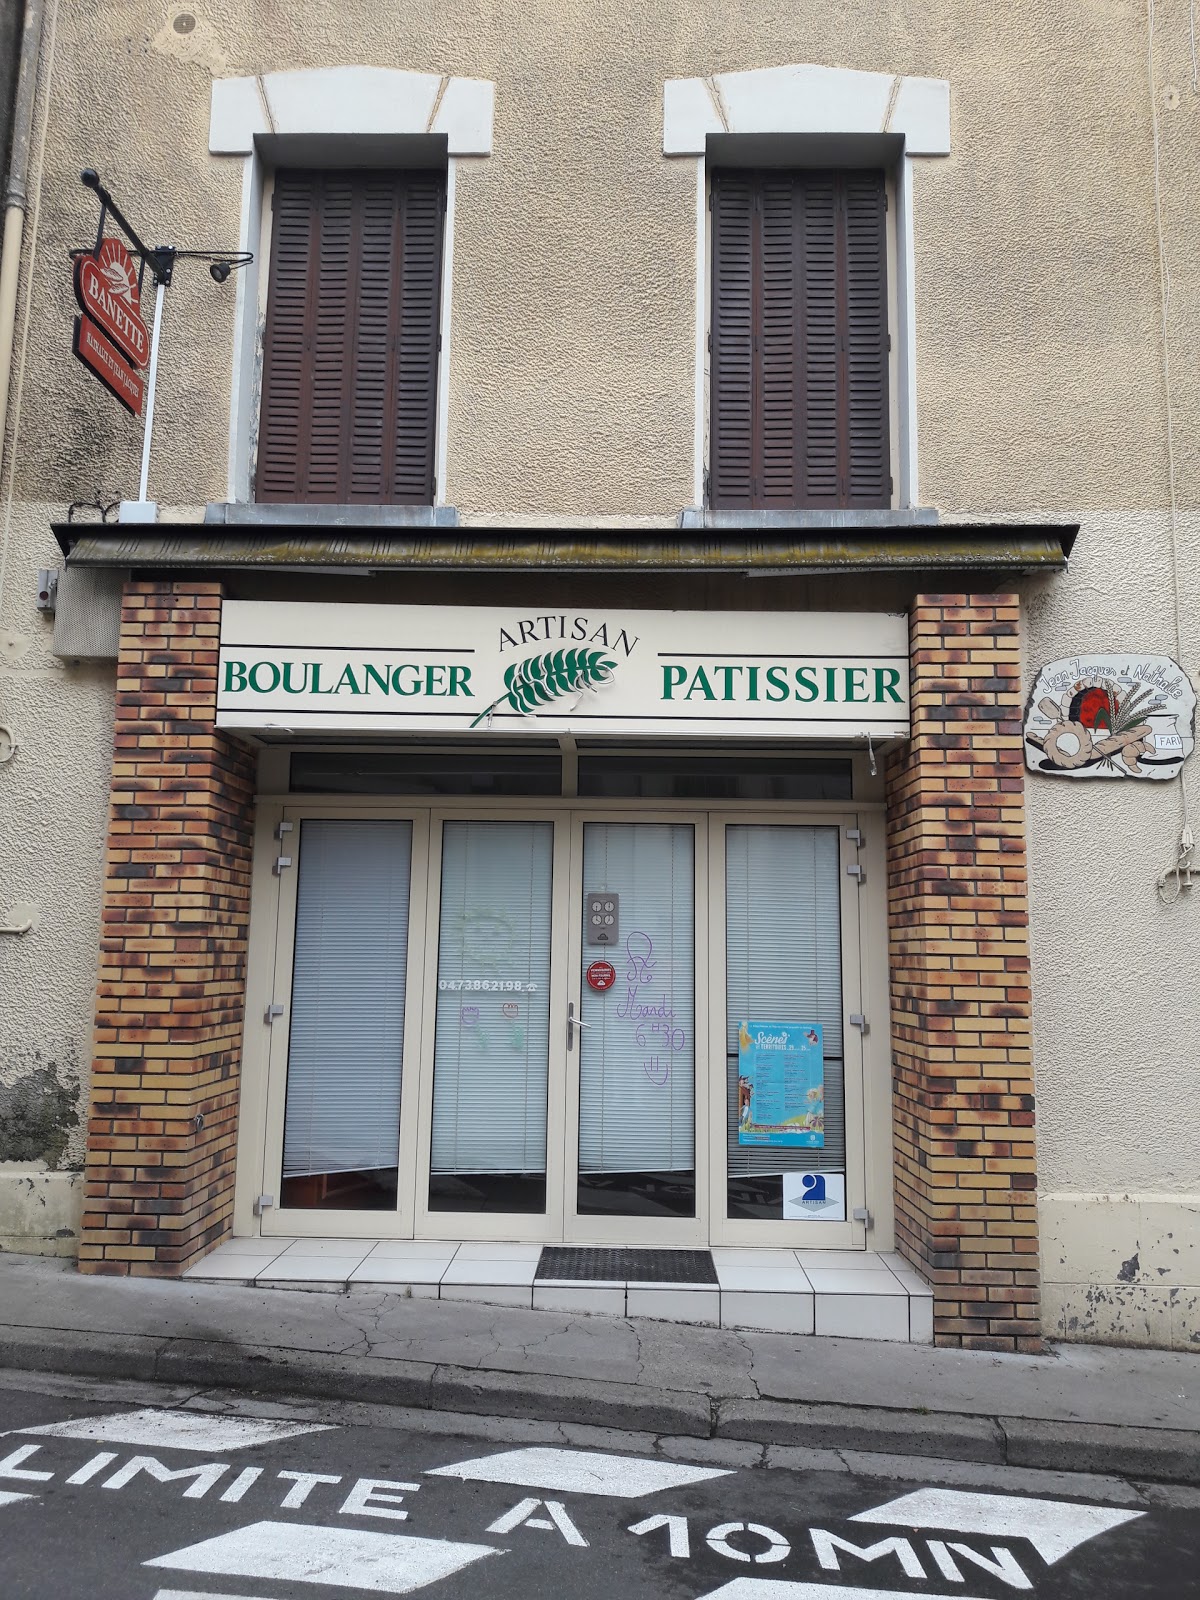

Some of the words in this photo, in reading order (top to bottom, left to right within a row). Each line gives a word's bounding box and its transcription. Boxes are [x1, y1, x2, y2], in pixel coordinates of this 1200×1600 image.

[88, 272, 145, 353] BANETTE
[498, 614, 641, 657] ARTISAN
[222, 660, 476, 697] BOULANGER
[660, 664, 906, 704] PATISSIER
[1120, 665, 1131, 676] et
[1133, 663, 1183, 700] Nathalie
[754, 1031, 788, 1045] Scènes
[0, 1444, 421, 1521] LIMITE
[485, 1497, 591, 1547] A
